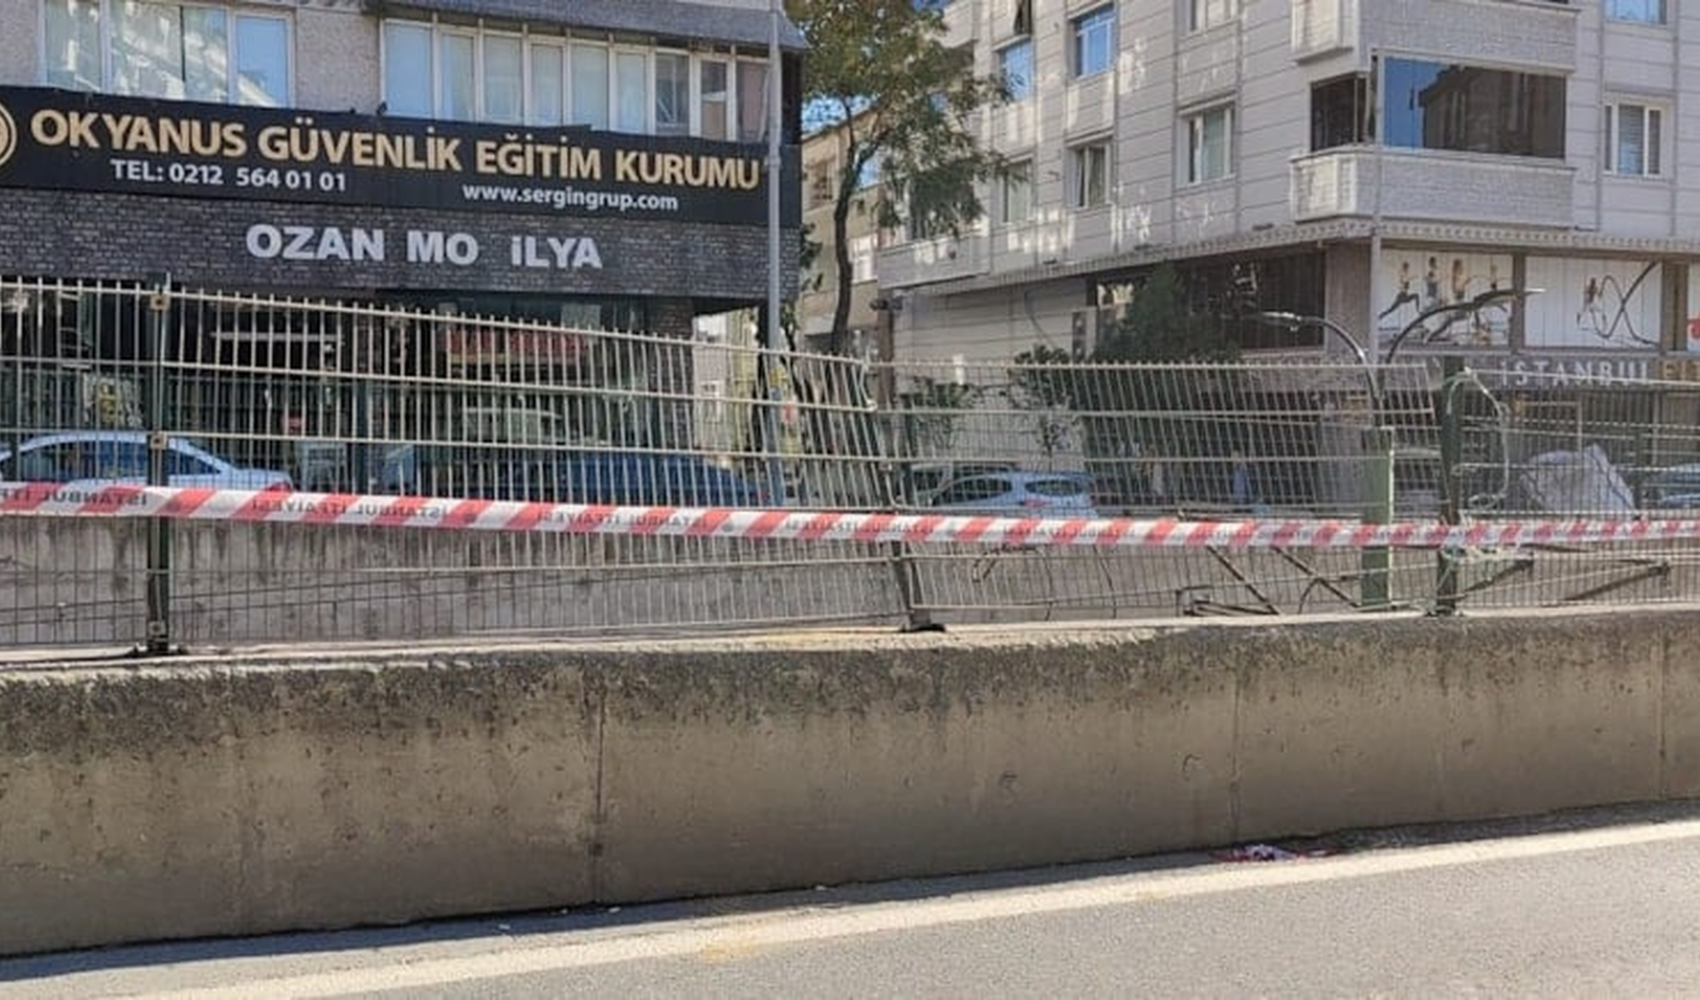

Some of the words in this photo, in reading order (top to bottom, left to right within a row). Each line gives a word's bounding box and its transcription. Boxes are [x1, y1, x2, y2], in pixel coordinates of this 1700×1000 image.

[31, 109, 247, 157] OKYANUS
[258, 117, 462, 173] GÜVENLİK
[476, 133, 602, 181] EĞİTİM
[615, 149, 760, 189] KURUMU
[111, 159, 164, 181] TEL:
[169, 163, 223, 185] 0212
[236, 168, 280, 188] 564
[286, 170, 313, 190] 01
[319, 173, 347, 191] 01
[463, 182, 679, 212] www.sergingrup.com
[246, 224, 385, 262] OZAN
[407, 230, 479, 265] MO
